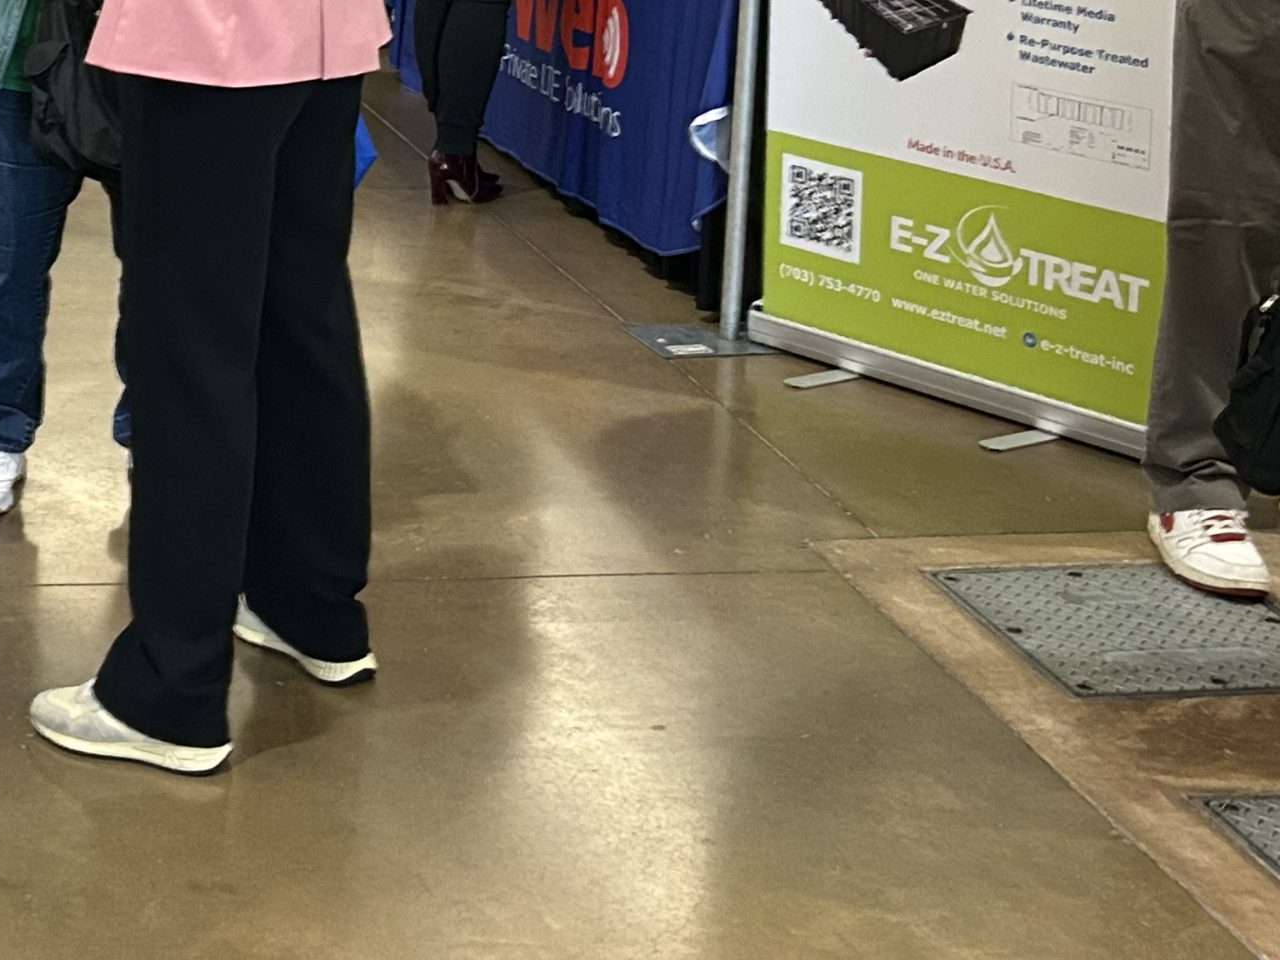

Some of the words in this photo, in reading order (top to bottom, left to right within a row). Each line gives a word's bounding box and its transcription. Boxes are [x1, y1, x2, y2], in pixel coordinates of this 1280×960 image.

[1020, 12, 1080, 33] Warranty
[1076, 7, 1116, 23] Media
[1018, 49, 1096, 74] Wastewater
[1019, 34, 1094, 59] Re-Purpose
[1097, 48, 1149, 69] Treated
[540, 63, 561, 102] LTE
[565, 75, 621, 138] Solutions
[906, 138, 940, 156] Made
[942, 146, 954, 159] in
[956, 149, 977, 164] the
[778, 262, 815, 287] (703)
[817, 273, 881, 304] 753-4770
[889, 215, 951, 263] E-Z
[1020, 247, 1150, 314] TREAT
[913, 268, 940, 287] ONE
[942, 276, 987, 300] WATER
[991, 286, 1068, 321] SOLUTIONS
[891, 295, 1008, 340] www.eztreat.net
[1040, 338, 1135, 377] e-z-treat-inc
